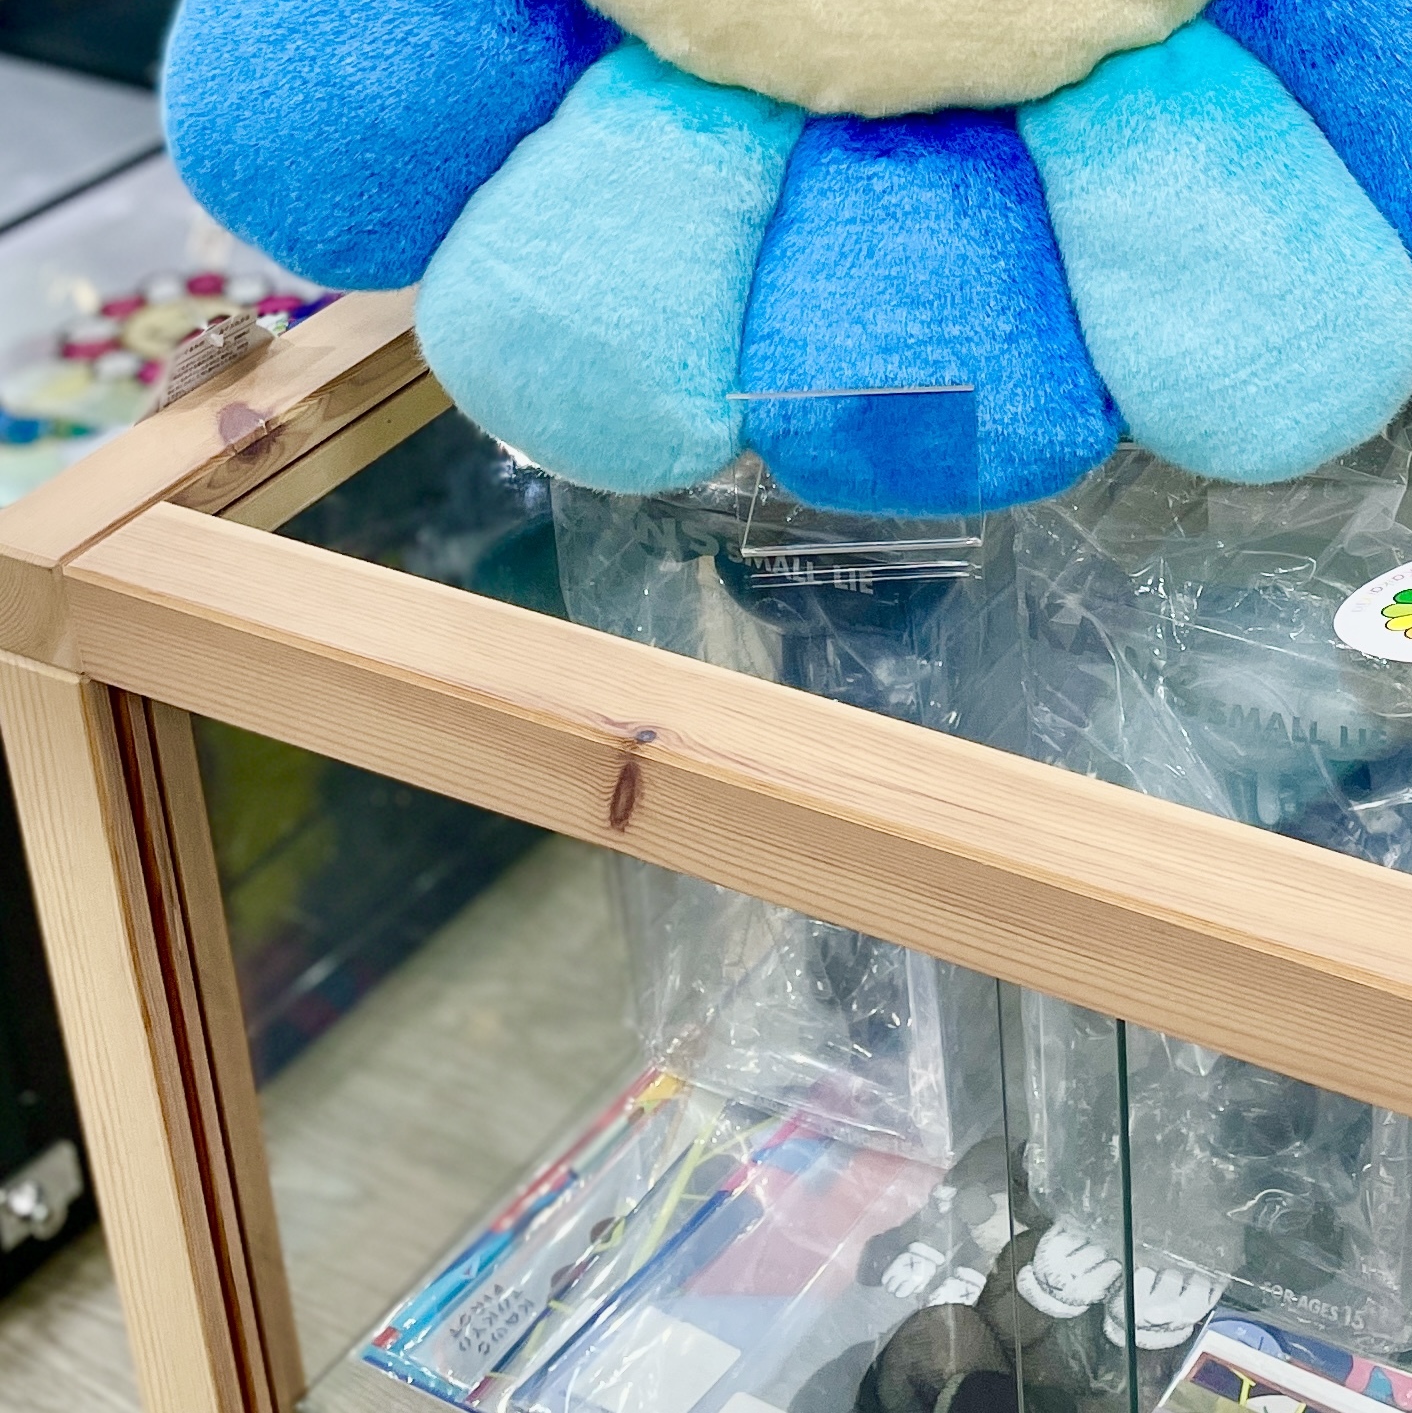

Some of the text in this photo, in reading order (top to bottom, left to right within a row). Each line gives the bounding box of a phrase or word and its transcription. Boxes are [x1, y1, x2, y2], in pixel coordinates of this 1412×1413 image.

[1206, 698, 1326, 745] SMALL
[459, 1289, 524, 1352] TOKYO
[1297, 1295, 1339, 1322] AGES
